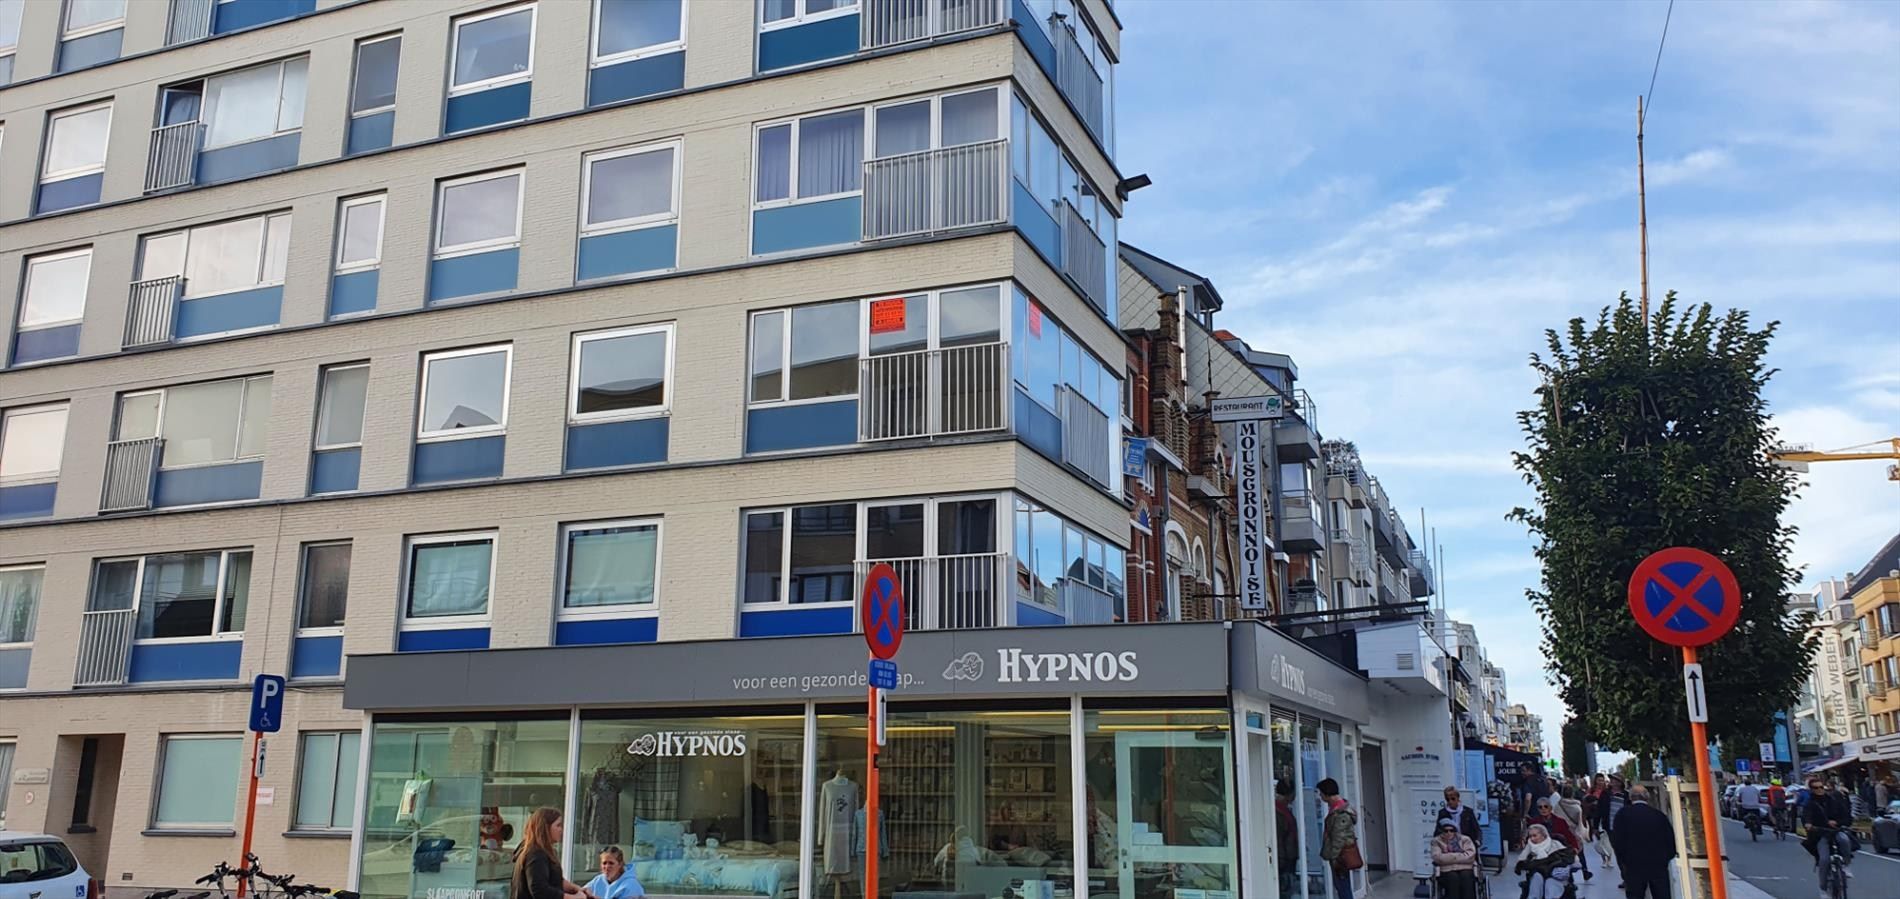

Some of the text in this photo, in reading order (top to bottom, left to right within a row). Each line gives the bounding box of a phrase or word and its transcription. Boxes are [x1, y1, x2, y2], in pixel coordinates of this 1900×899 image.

[997, 648, 1139, 682] HYPNOS
[260, 679, 279, 709] P
[733, 674, 767, 689] voor
[769, 676, 797, 689] een
[801, 670, 866, 692] gezonde
[1826, 636, 1848, 737] GERRY WEBER
[656, 732, 746, 756] HYPNOS
[1497, 767, 1517, 775] JOUR
